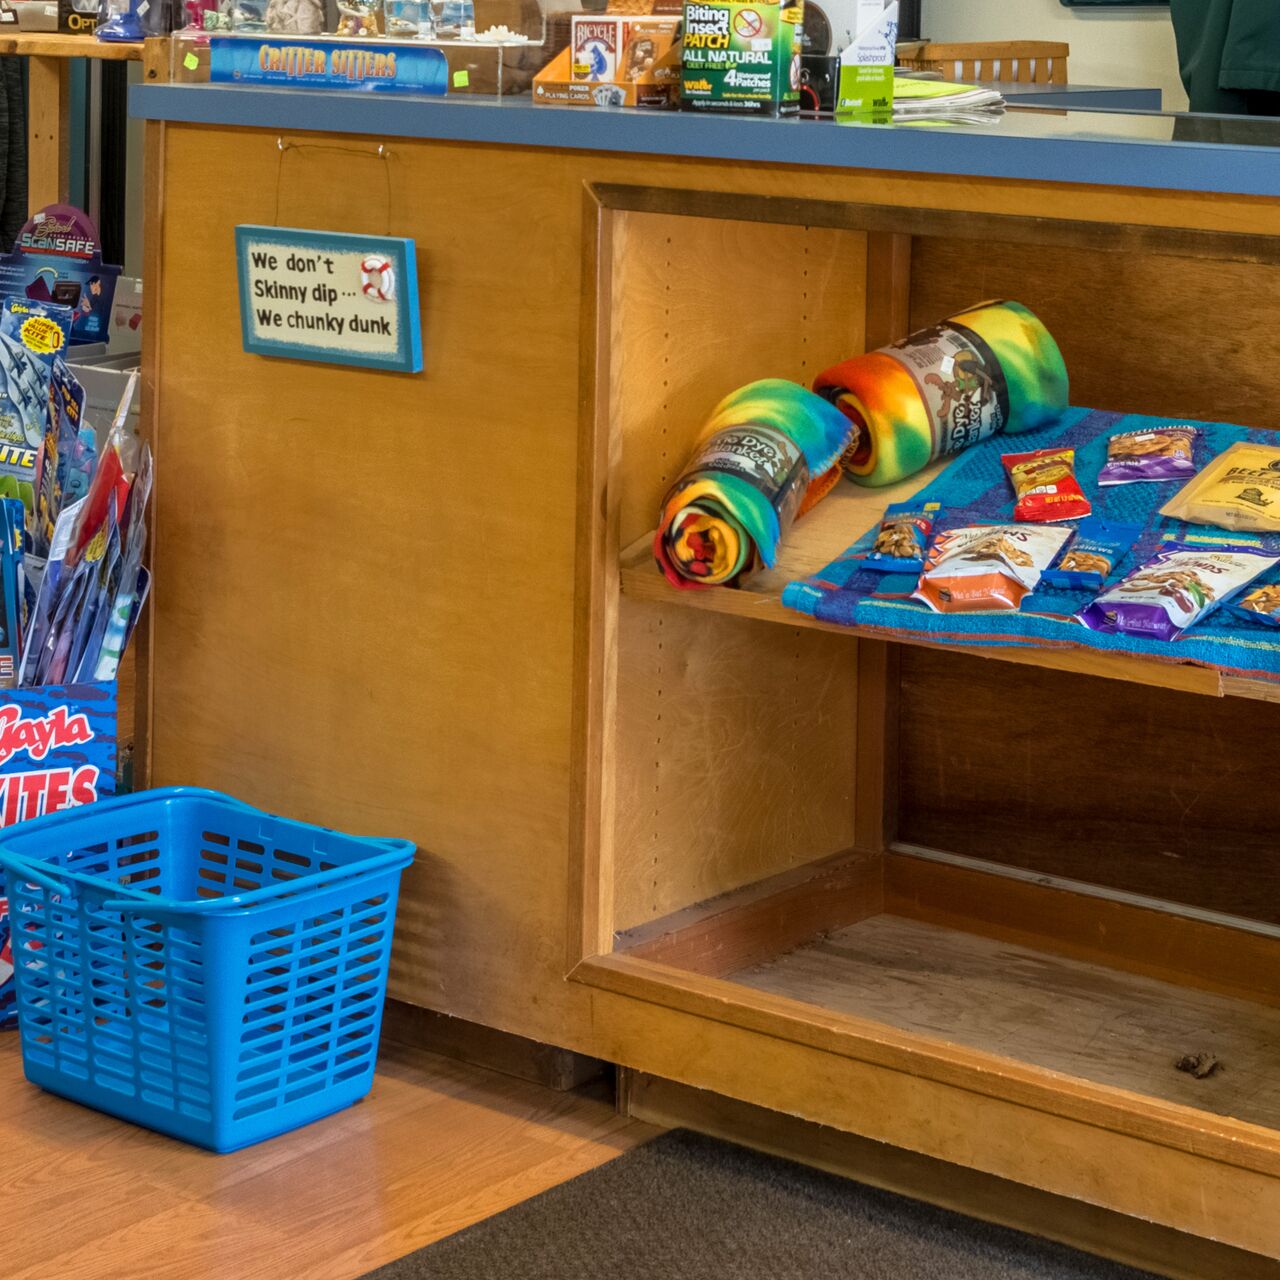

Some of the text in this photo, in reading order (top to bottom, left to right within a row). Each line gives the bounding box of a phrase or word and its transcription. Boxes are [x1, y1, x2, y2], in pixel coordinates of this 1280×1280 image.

[686, 6, 729, 21] Biting
[576, 23, 616, 46] BICYCLE
[686, 21, 729, 35] Insect
[683, 33, 730, 49] PATCH
[258, 44, 326, 77] CRITTER
[330, 49, 396, 80] SITTERS
[683, 50, 772, 64] ALL NATURAL
[724, 69, 737, 87] 4
[736, 79, 771, 88] Patches
[252, 252, 334, 274] We don't
[255, 279, 338, 306] Skinny dip
[26, 323, 49, 336] VALUE
[33, 318, 56, 331] SUPER
[256, 309, 391, 336] We chunky dunk
[23, 328, 48, 342] KITE
